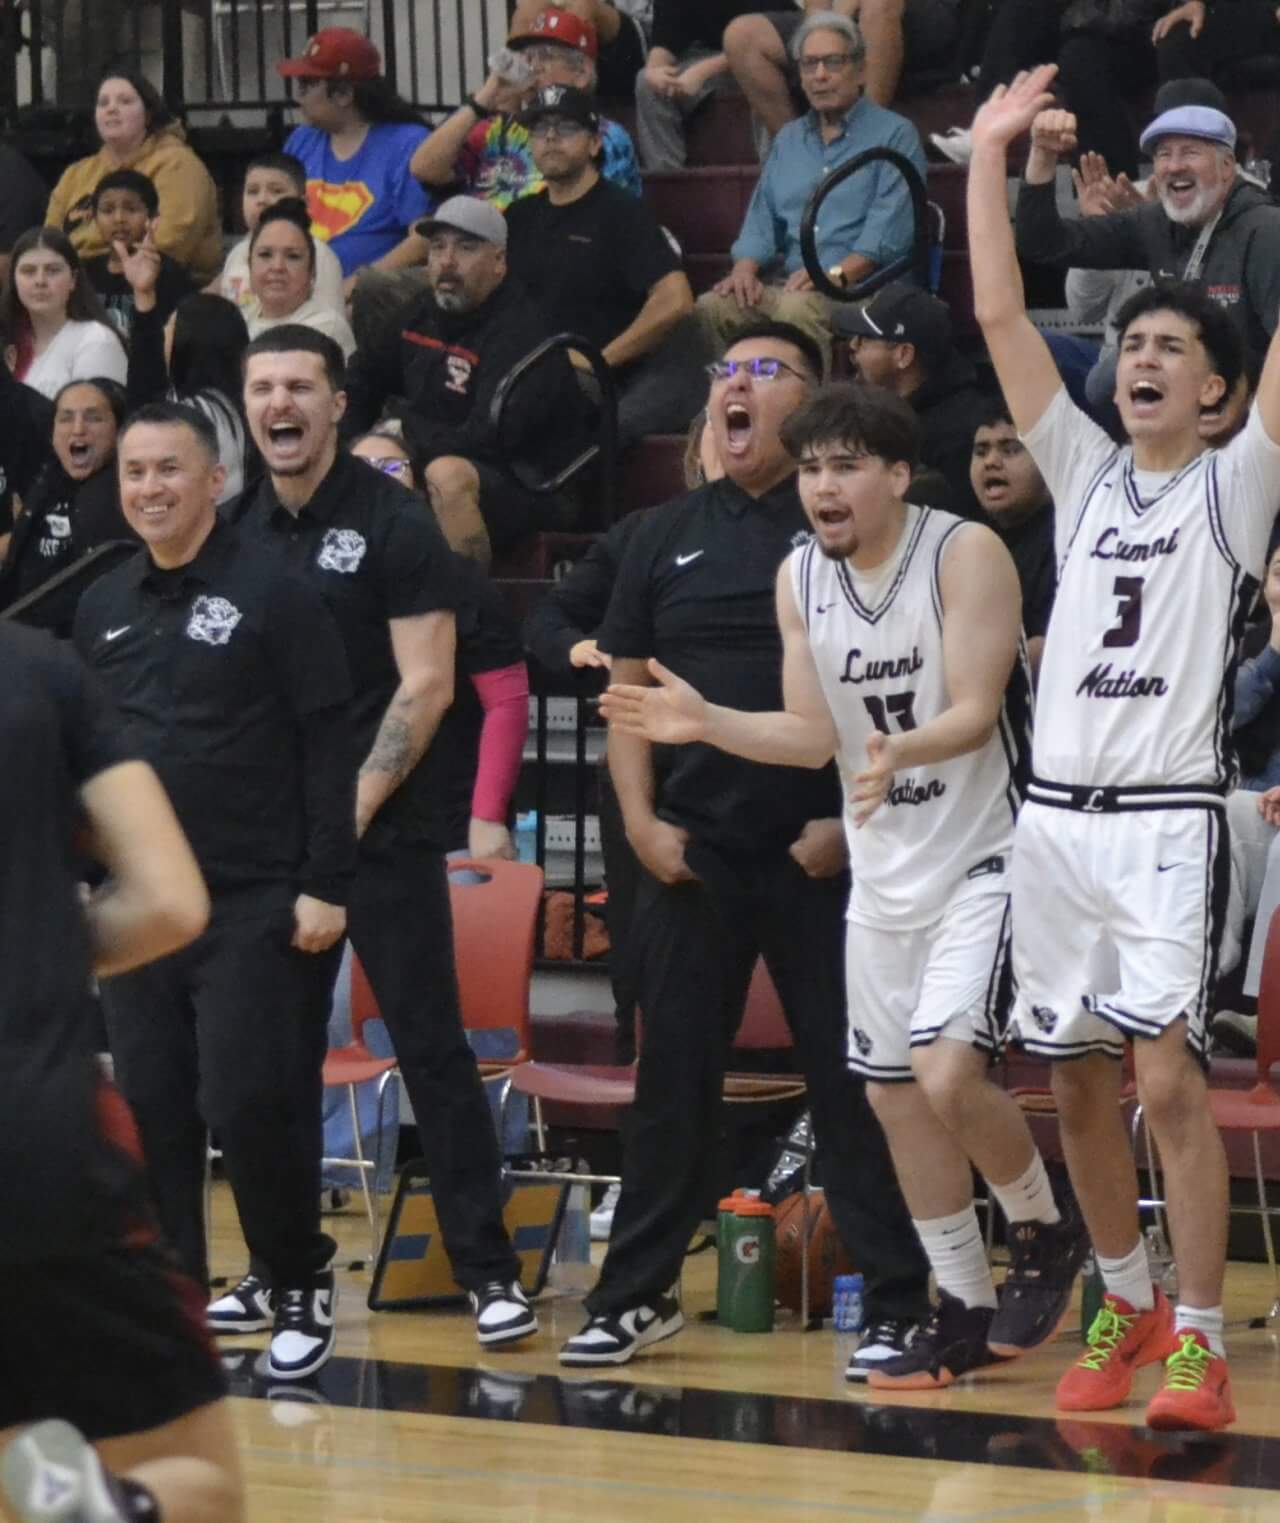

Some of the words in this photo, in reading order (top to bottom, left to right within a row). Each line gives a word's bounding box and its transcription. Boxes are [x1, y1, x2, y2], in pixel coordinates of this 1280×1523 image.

[1090, 527, 1180, 562] Lummi
[1103, 576, 1145, 648] 3
[840, 646, 924, 684] Lummi
[1076, 662, 1168, 699] Nation
[885, 777, 946, 806] ation
[1082, 789, 1104, 812] L
[736, 1235, 760, 1264] G
